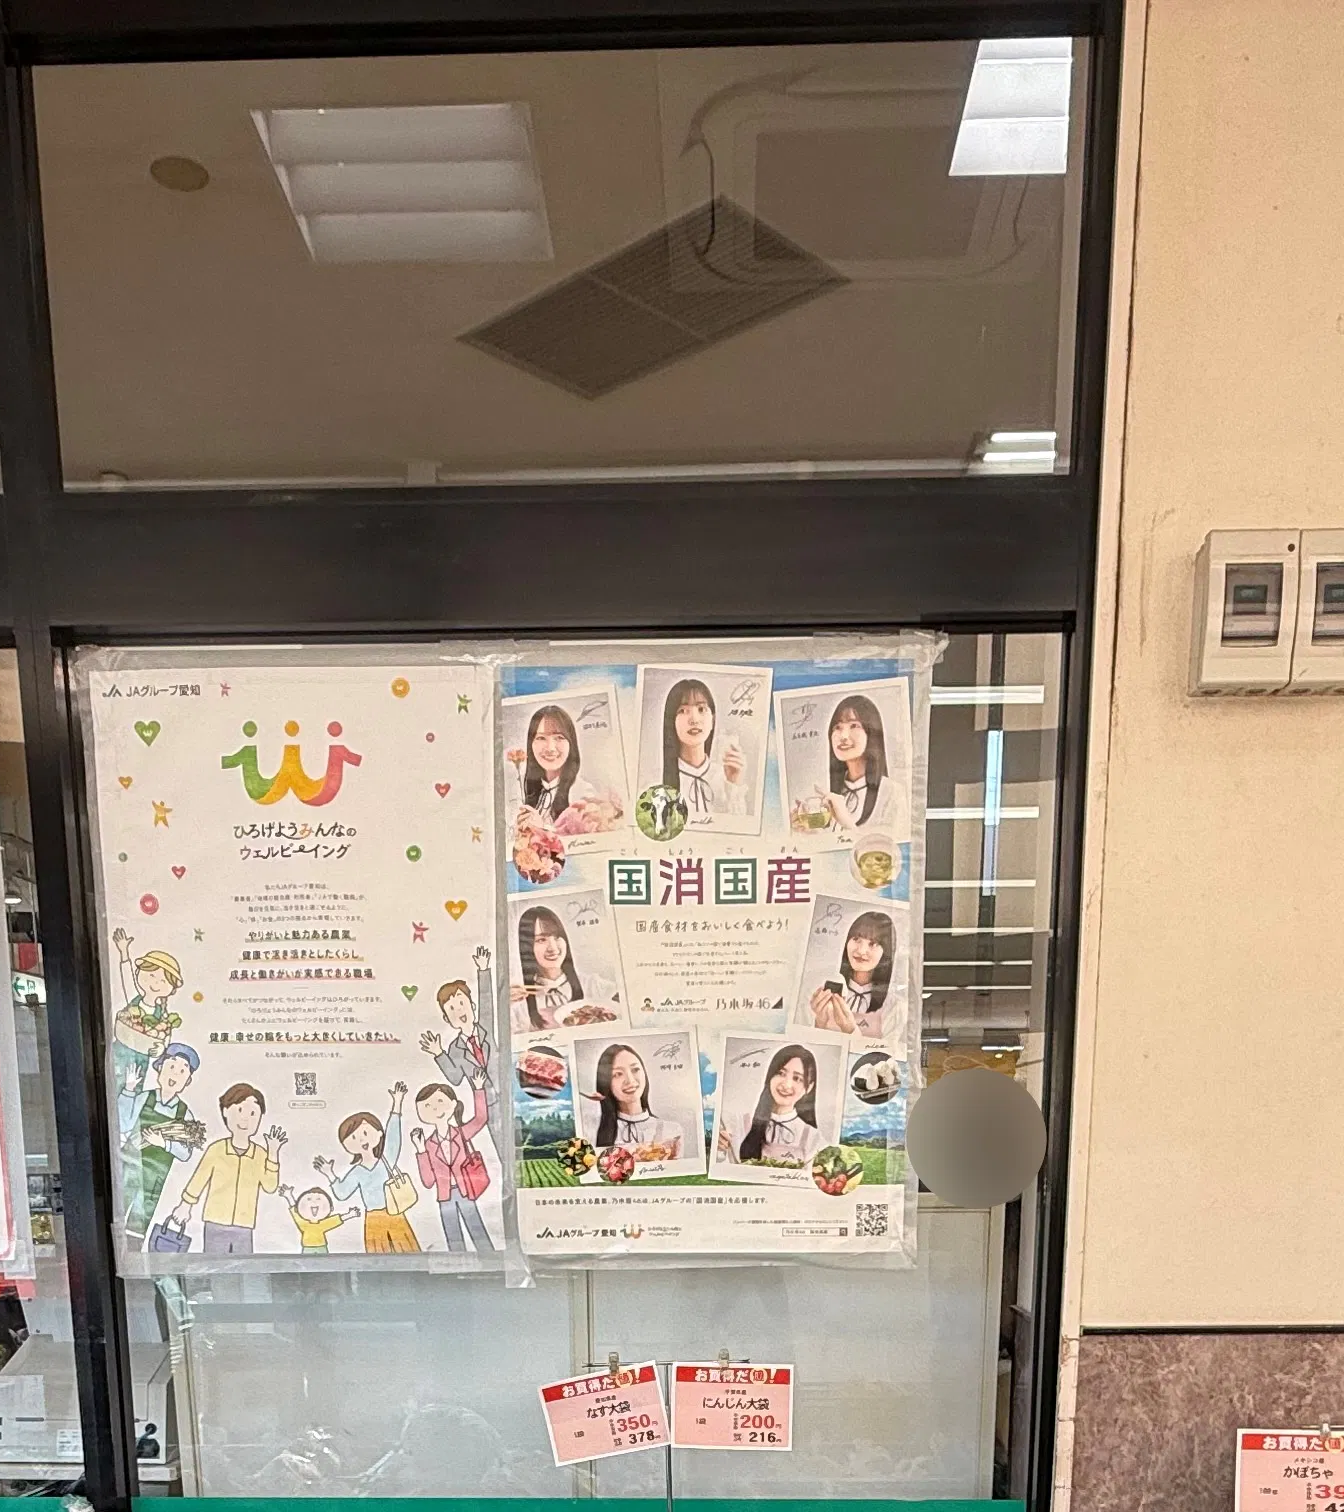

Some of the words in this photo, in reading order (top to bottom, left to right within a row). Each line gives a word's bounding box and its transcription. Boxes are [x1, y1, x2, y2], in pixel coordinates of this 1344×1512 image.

[126, 684, 201, 697] JAグループ愛知
[233, 821, 357, 840] ひろげようみんなの
[240, 843, 352, 860] ウェルビーイング
[608, 856, 811, 905] 国消国産
[587, 1400, 631, 1418] なす大袋
[702, 1397, 770, 1410] にんじん大袋
[616, 1413, 658, 1433] 350円
[740, 1414, 782, 1429] 200円
[1283, 1465, 1334, 1479] かぼちゃ
